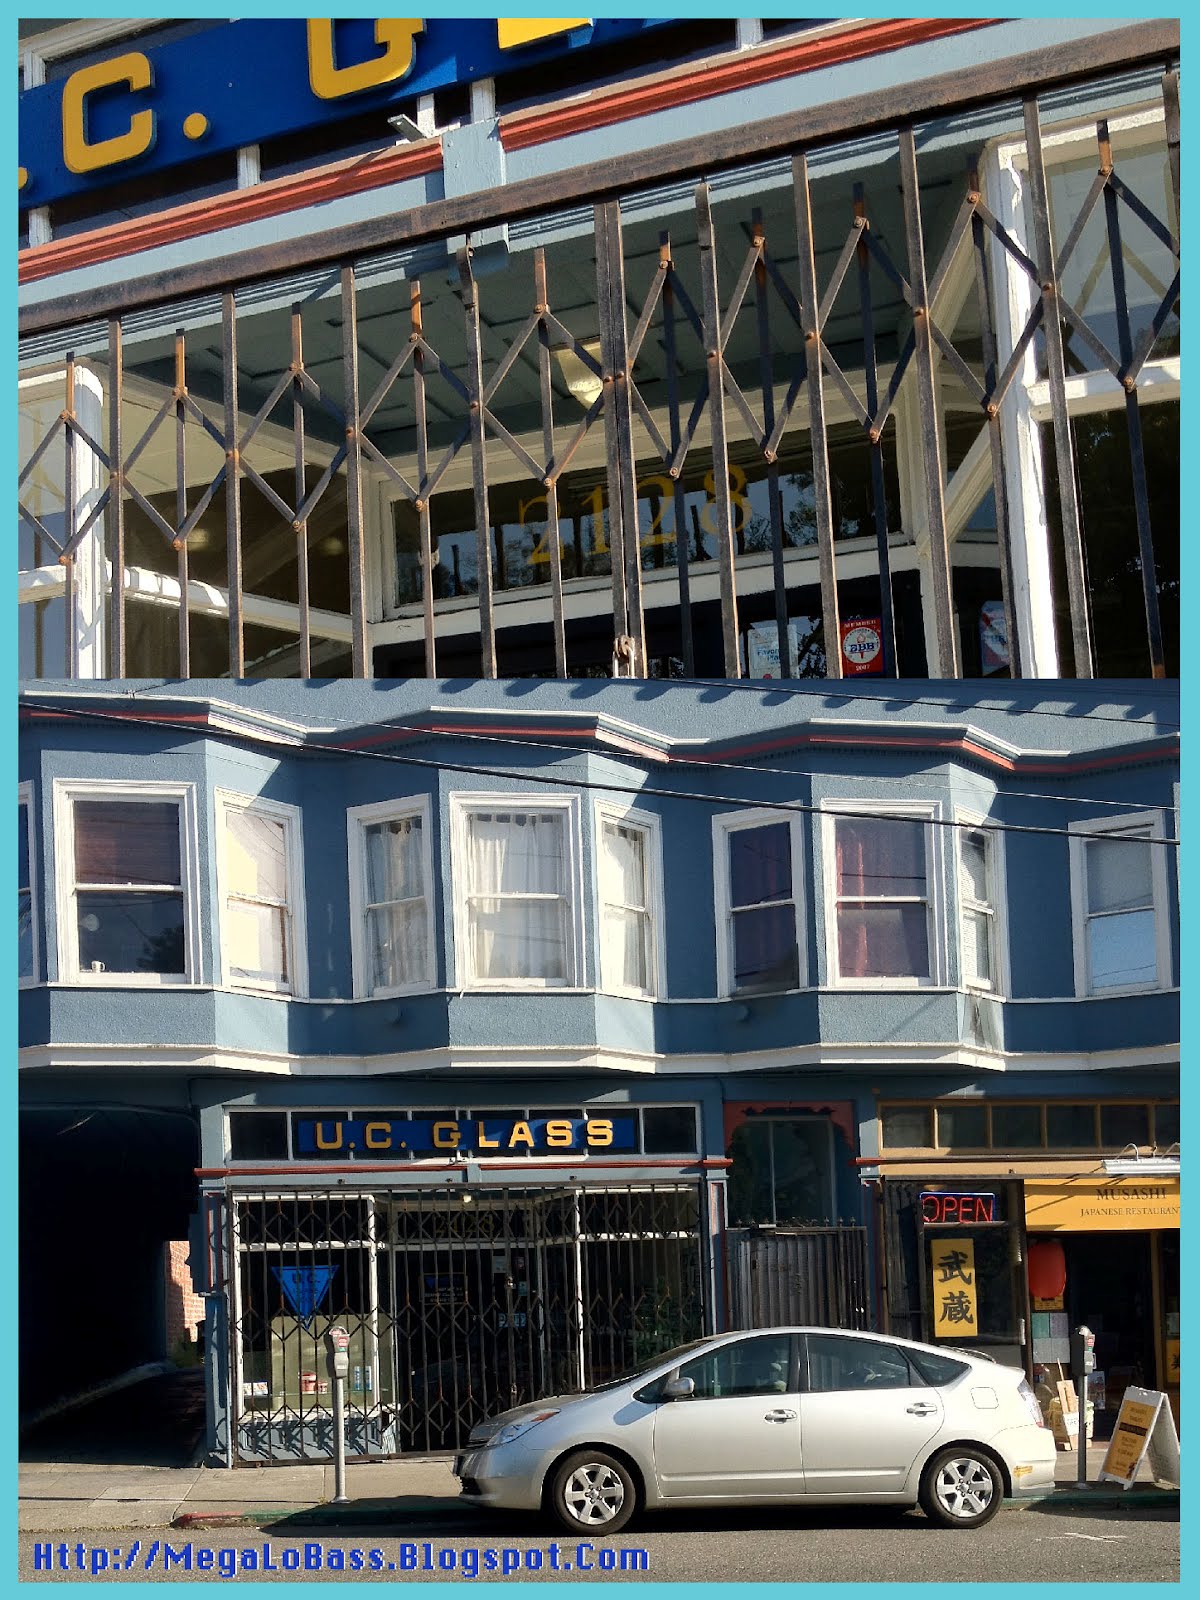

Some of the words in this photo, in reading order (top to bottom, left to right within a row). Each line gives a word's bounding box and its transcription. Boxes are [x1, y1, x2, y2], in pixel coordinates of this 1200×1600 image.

[518, 464, 753, 565] 2128
[432, 1120, 613, 1148] GLASS
[1096, 1187, 1168, 1201] MUSASHI
[921, 1196, 994, 1223] OPEN
[1080, 1207, 1122, 1217] JAPANESE
[937, 1250, 974, 1325] 武蔵
